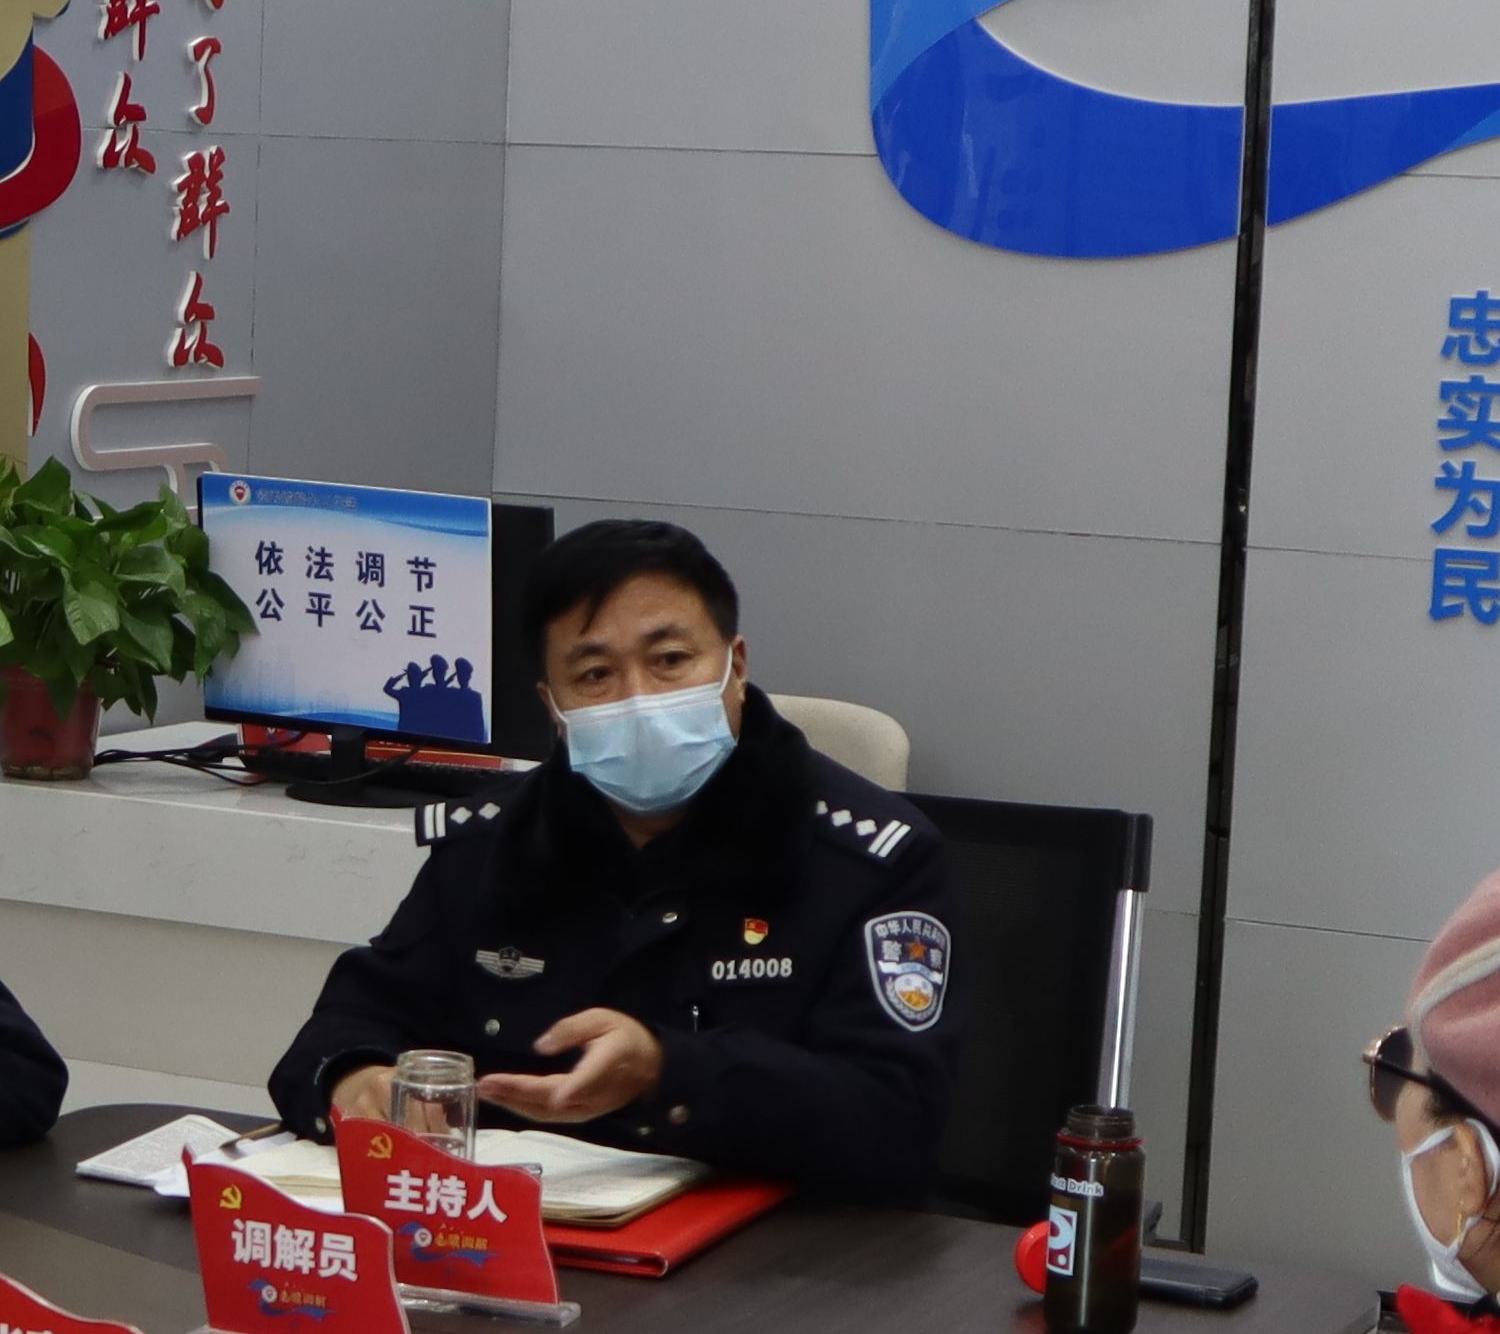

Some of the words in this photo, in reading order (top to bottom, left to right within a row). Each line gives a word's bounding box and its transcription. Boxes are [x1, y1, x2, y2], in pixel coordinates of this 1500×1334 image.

[255, 540, 437, 593] 依法调节
[255, 587, 437, 639] 公平公正
[712, 957, 793, 981] 014008
[384, 1169, 508, 1224] 主持人
[231, 1219, 358, 1282] 调解员
